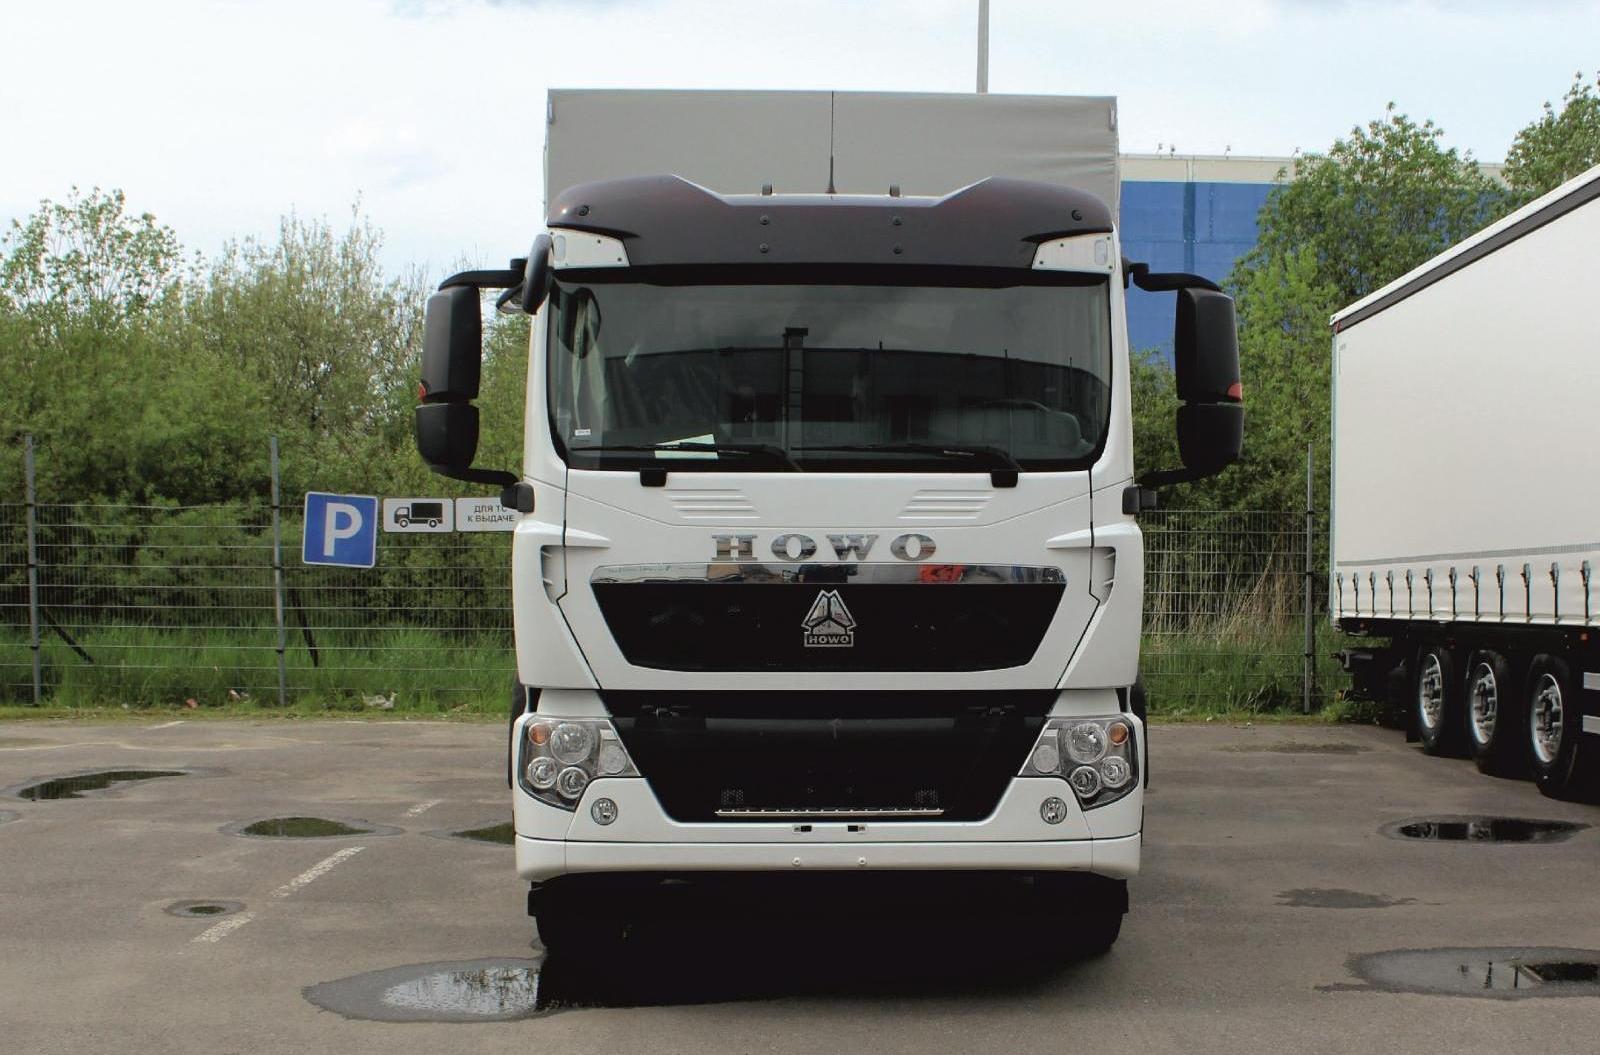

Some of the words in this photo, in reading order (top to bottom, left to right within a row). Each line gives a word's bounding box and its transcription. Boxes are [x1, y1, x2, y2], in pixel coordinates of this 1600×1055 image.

[474, 504, 494, 513] ДЛЯ
[475, 514, 515, 522] ВЫДАЧЕ
[323, 502, 363, 557] P
[711, 533, 937, 561] HOWO
[808, 634, 850, 645] HOWO
